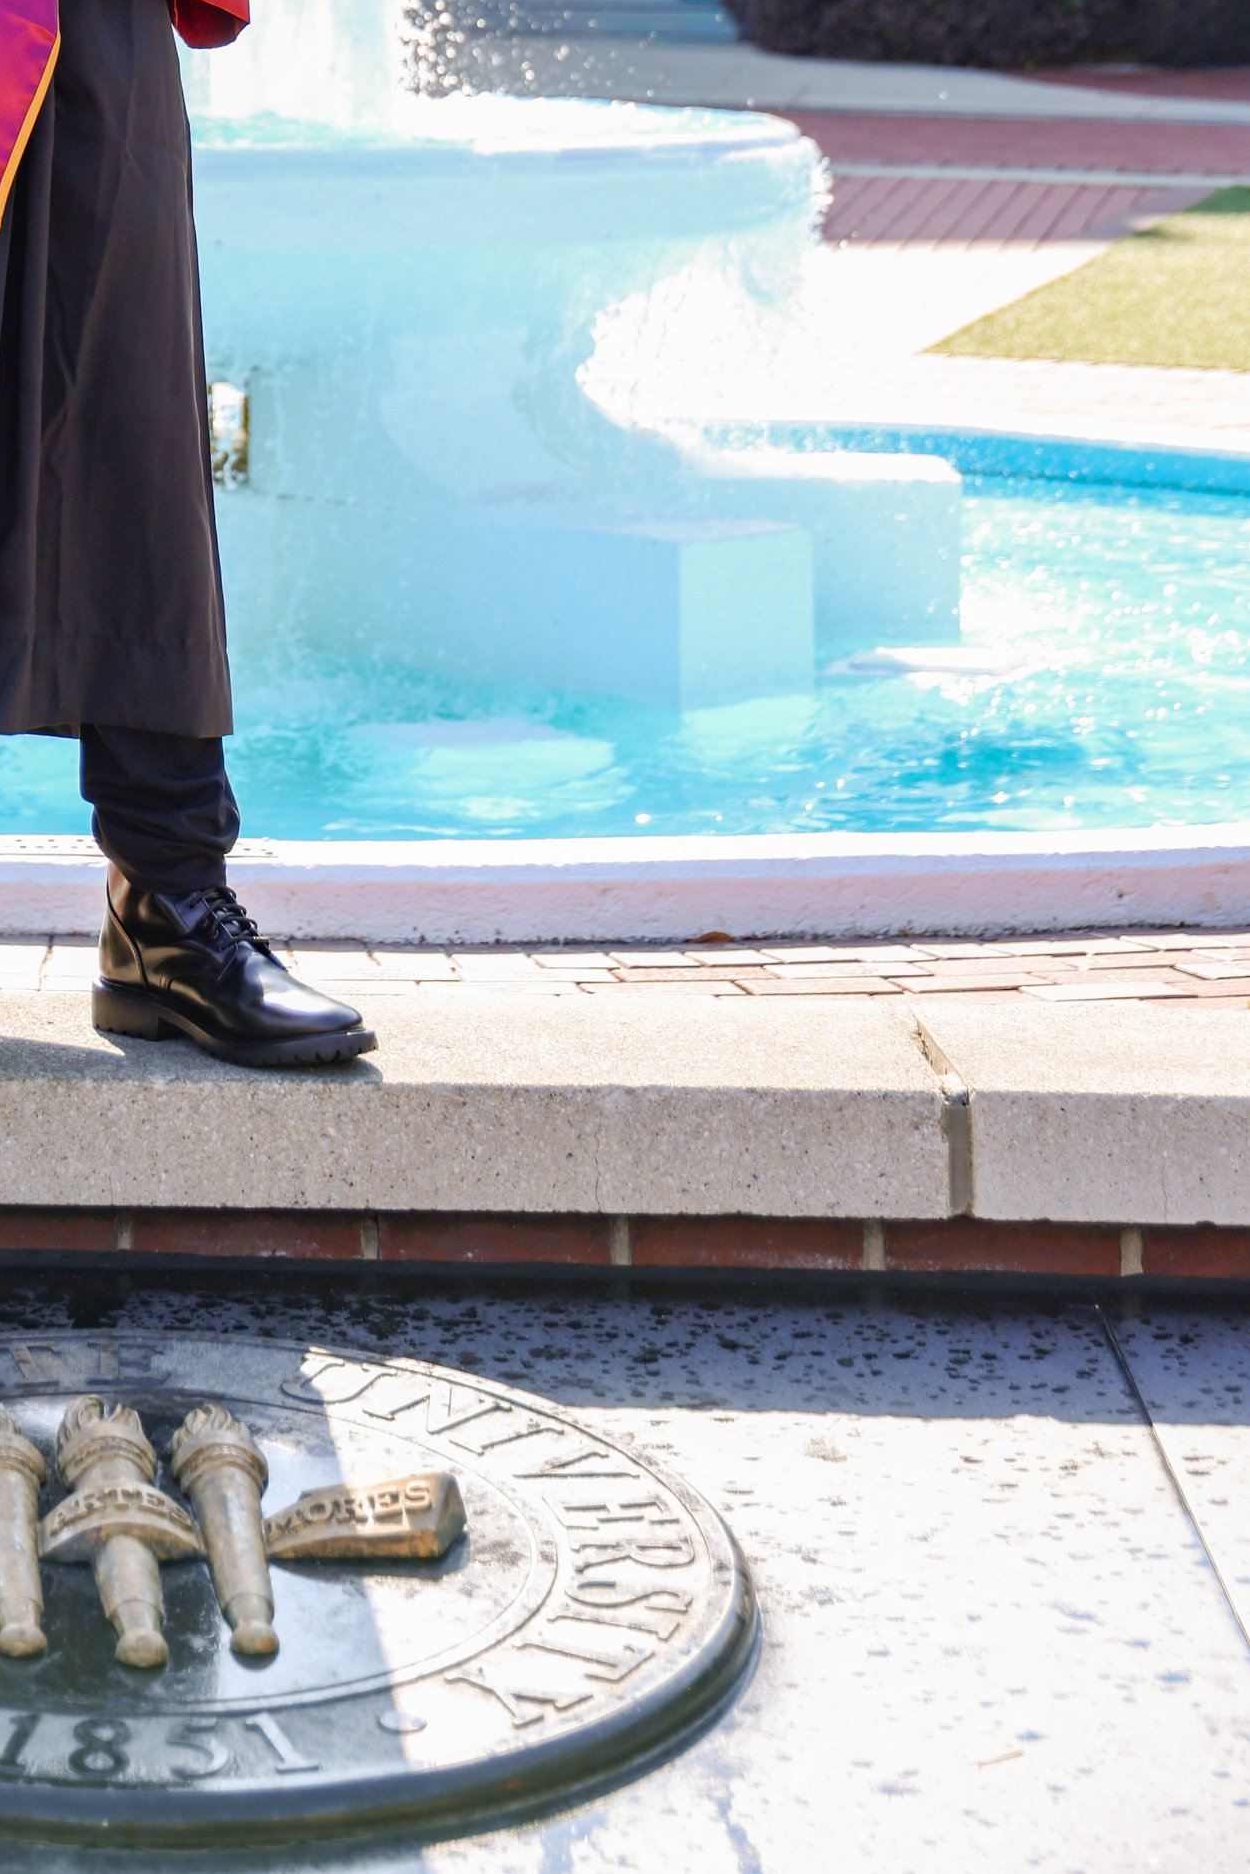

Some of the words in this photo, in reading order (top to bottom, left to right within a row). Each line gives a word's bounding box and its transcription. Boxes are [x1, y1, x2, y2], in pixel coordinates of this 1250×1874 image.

[50, 1485, 195, 1533] ARTES
[264, 1479, 433, 1538] MORES
[280, 1355, 695, 1728] UNIVERSITY
